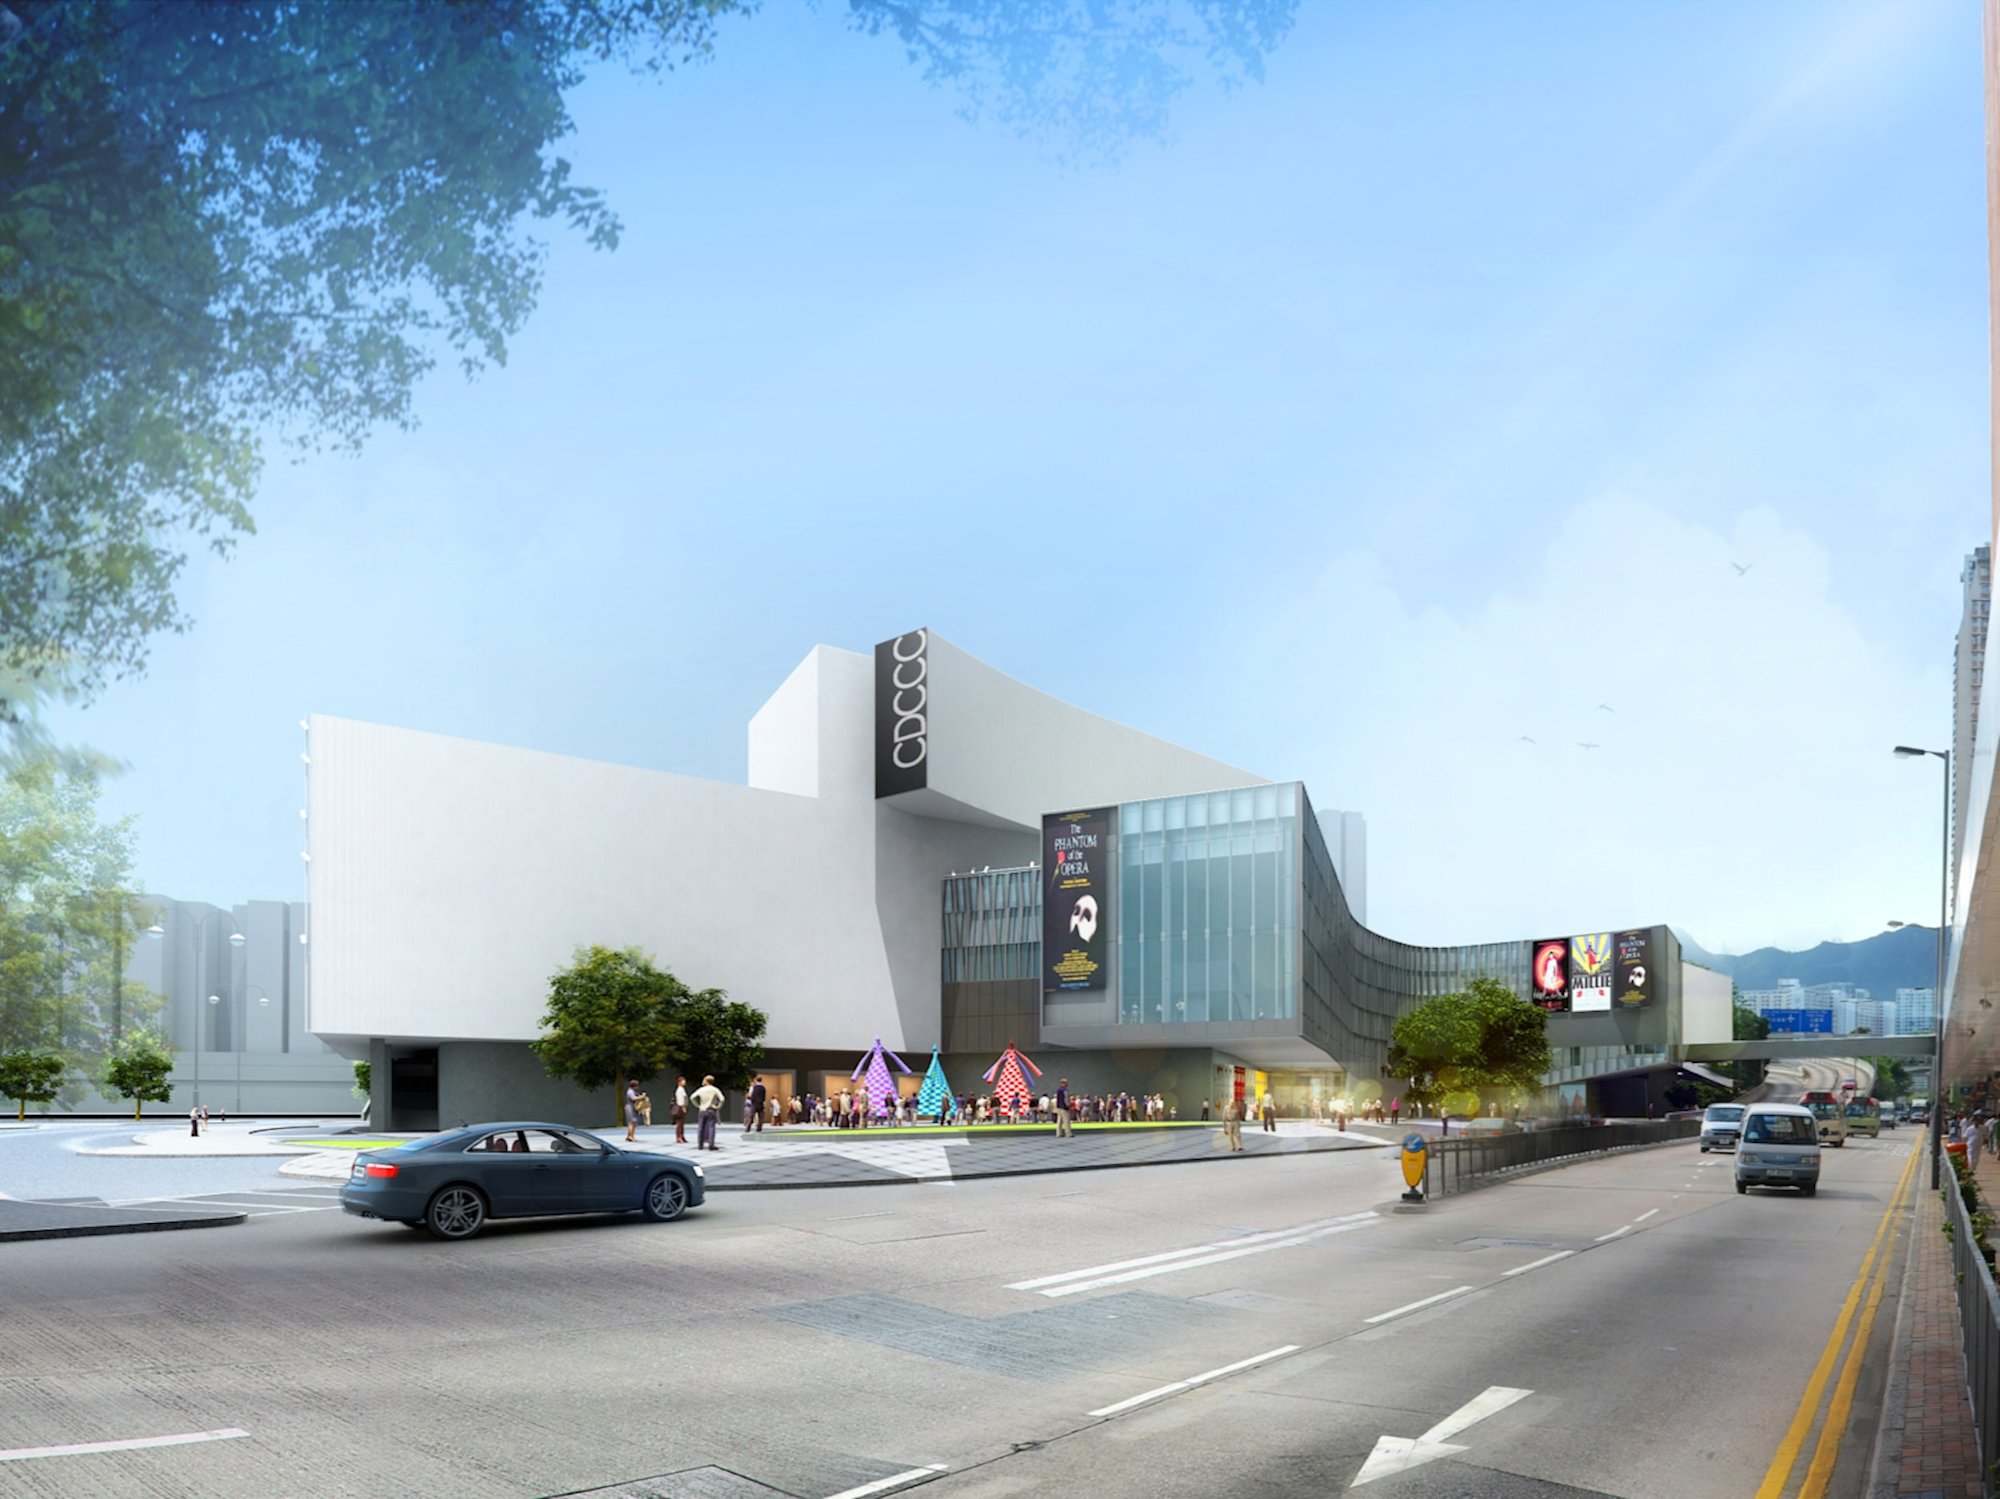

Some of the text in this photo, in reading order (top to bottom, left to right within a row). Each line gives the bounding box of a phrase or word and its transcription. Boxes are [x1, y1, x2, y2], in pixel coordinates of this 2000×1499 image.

[893, 630, 926, 768] CDCCC
[1070, 823, 1081, 834] The
[1054, 835, 1097, 850] PHANTOM
[1060, 862, 1089, 875] OPERA
[1572, 976, 1612, 989] MILLIE
